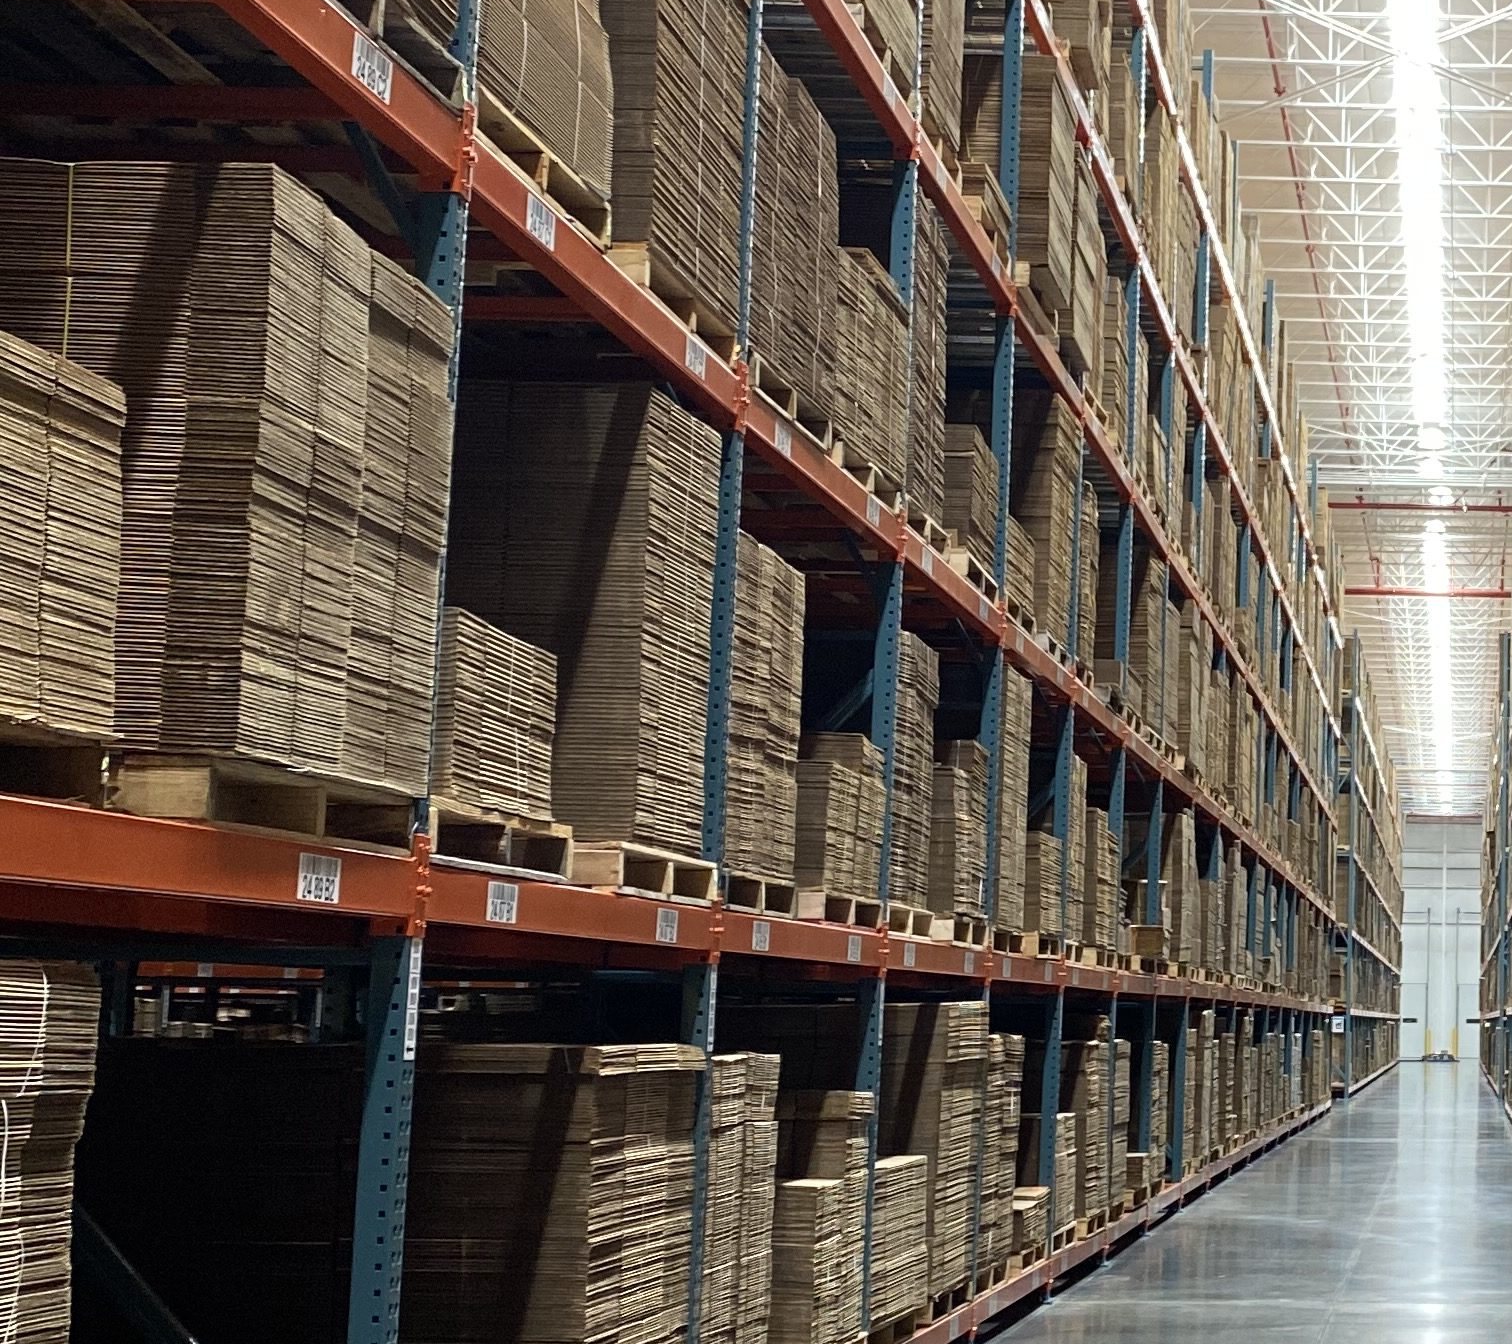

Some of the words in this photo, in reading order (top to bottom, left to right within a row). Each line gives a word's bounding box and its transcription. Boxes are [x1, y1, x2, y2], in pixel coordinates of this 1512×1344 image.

[356, 56, 366, 82] 24
[377, 74, 387, 101] C2
[302, 874, 312, 898] 24
[324, 878, 335, 902] B2
